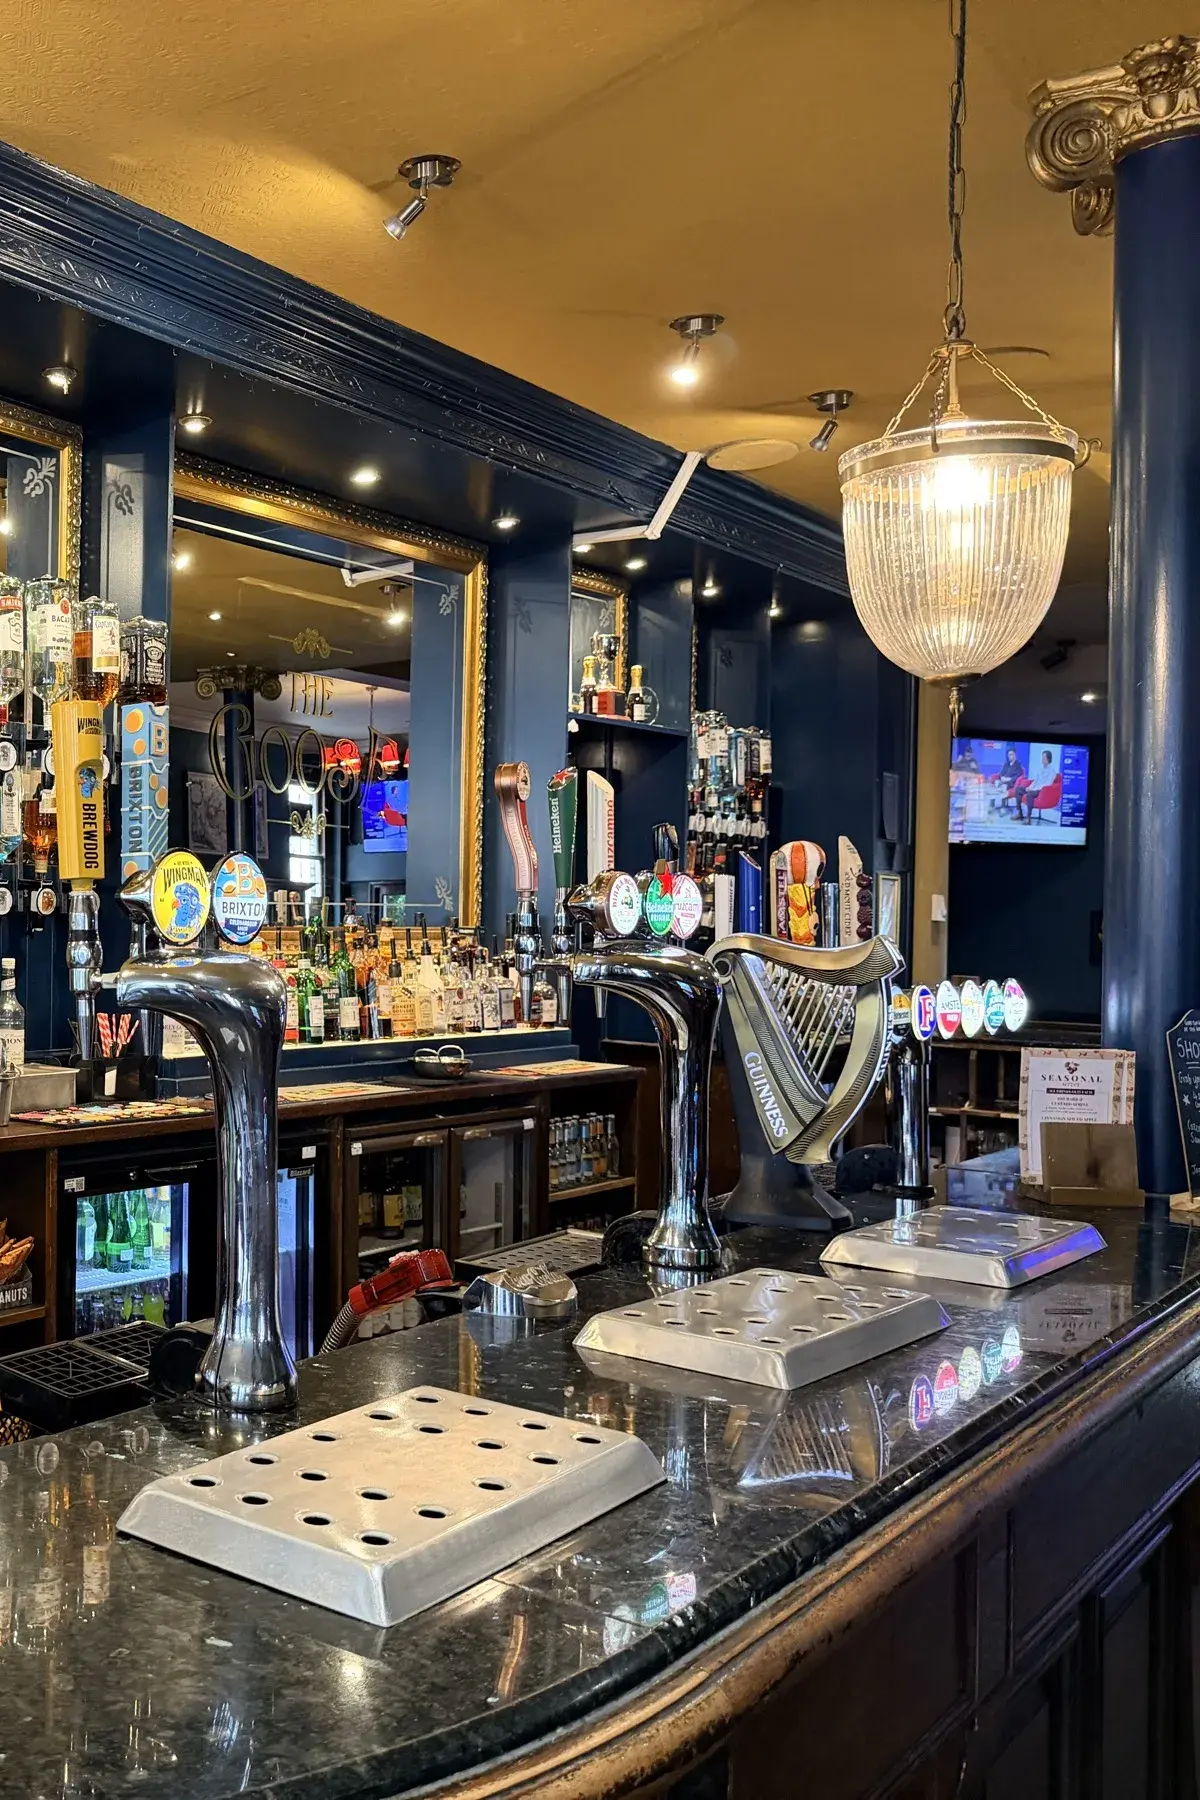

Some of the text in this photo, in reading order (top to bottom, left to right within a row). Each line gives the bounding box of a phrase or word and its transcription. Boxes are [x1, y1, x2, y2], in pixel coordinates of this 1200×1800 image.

[285, 671, 335, 718] THE
[128, 765, 143, 853] BRIXTON
[549, 796, 562, 854] Heineken
[82, 802, 100, 869] BREWDOG
[163, 867, 208, 894] WINGMAN
[222, 901, 266, 917] BRIXTON
[1176, 1037, 1200, 1059] SHO
[744, 1050, 789, 1138] GUINNESS
[1040, 1074, 1103, 1084] SEASONAL
